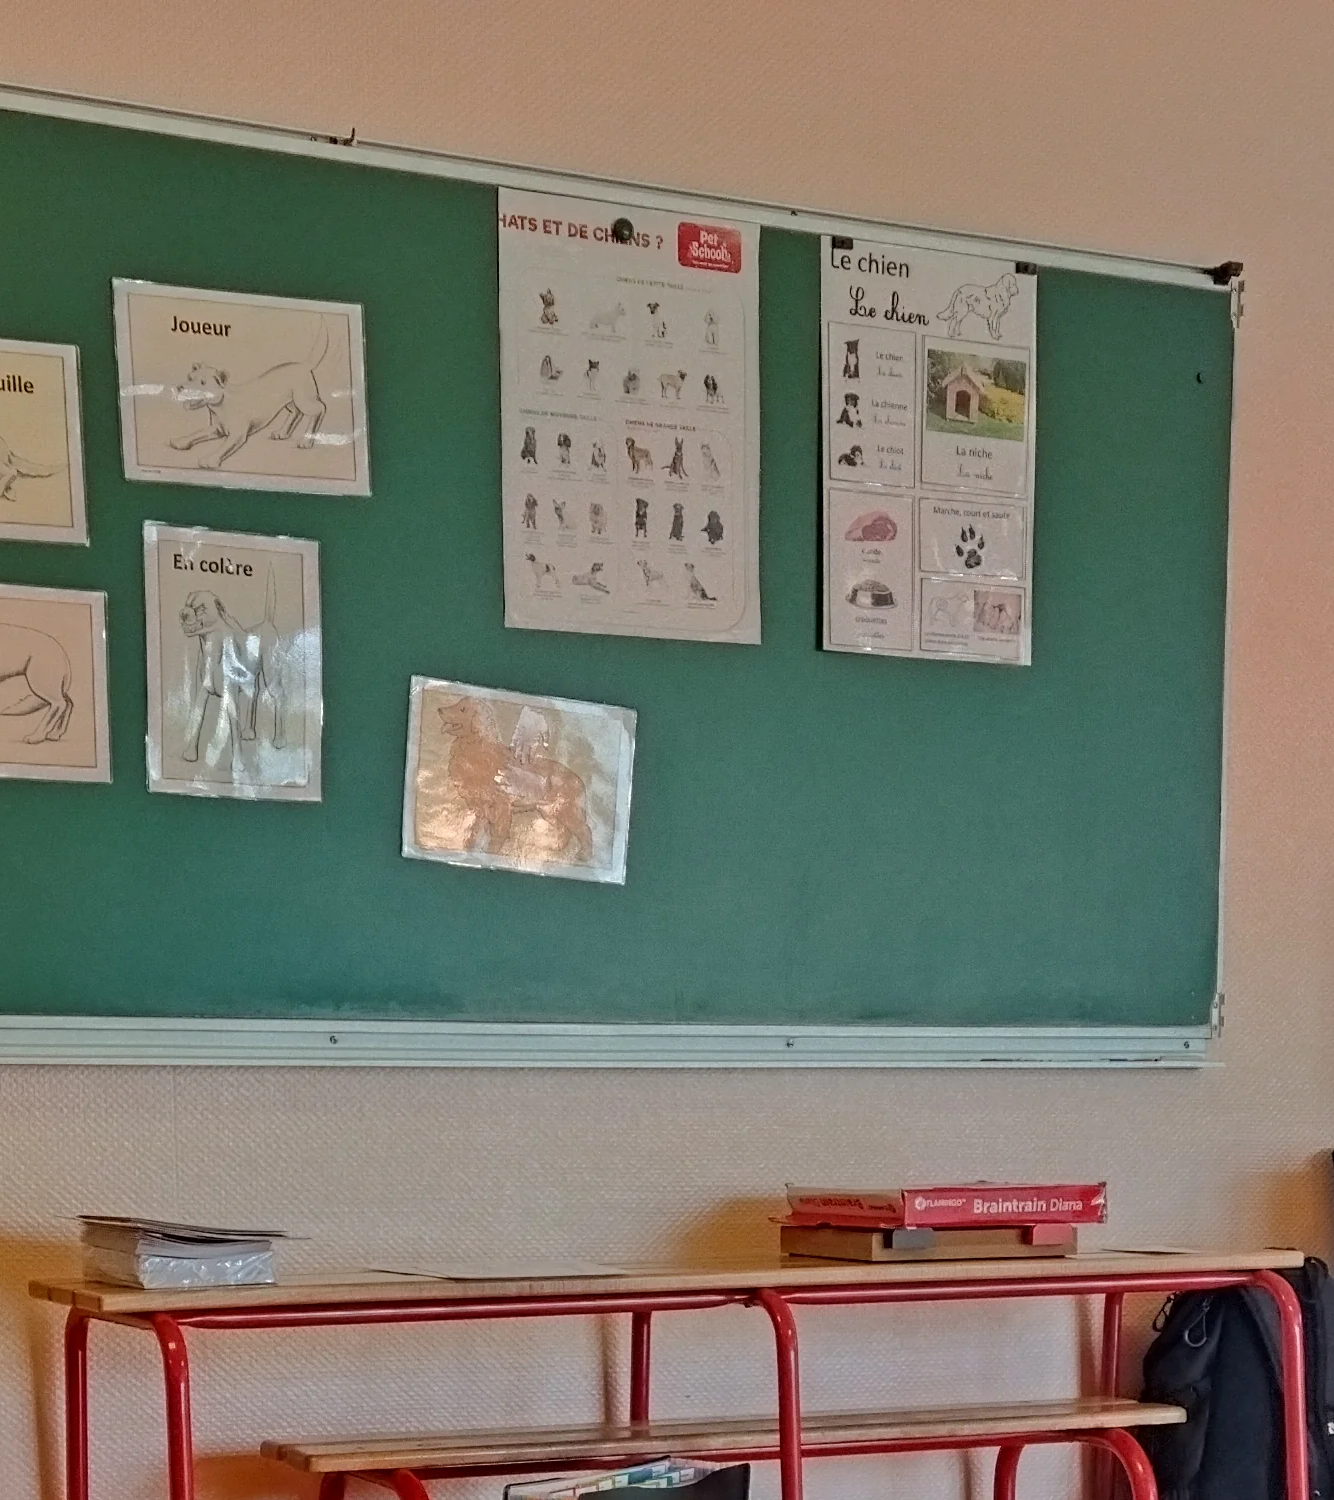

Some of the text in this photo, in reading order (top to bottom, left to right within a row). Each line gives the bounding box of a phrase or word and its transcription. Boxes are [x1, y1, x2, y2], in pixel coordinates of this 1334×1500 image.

[542, 218, 563, 236] ET
[568, 222, 589, 240] DE
[593, 226, 651, 248] CHNS
[655, 234, 664, 250] ?
[699, 229, 719, 246] Pet
[690, 240, 727, 262] School
[831, 248, 910, 279] Le chien
[849, 284, 930, 326] Le chien
[170, 315, 232, 337] Joueur
[875, 351, 884, 360] Le
[956, 445, 993, 460] La niche
[173, 553, 254, 577] En colère
[973, 1197, 1047, 1214] Braintrain
[1049, 1198, 1084, 1212] Diana
